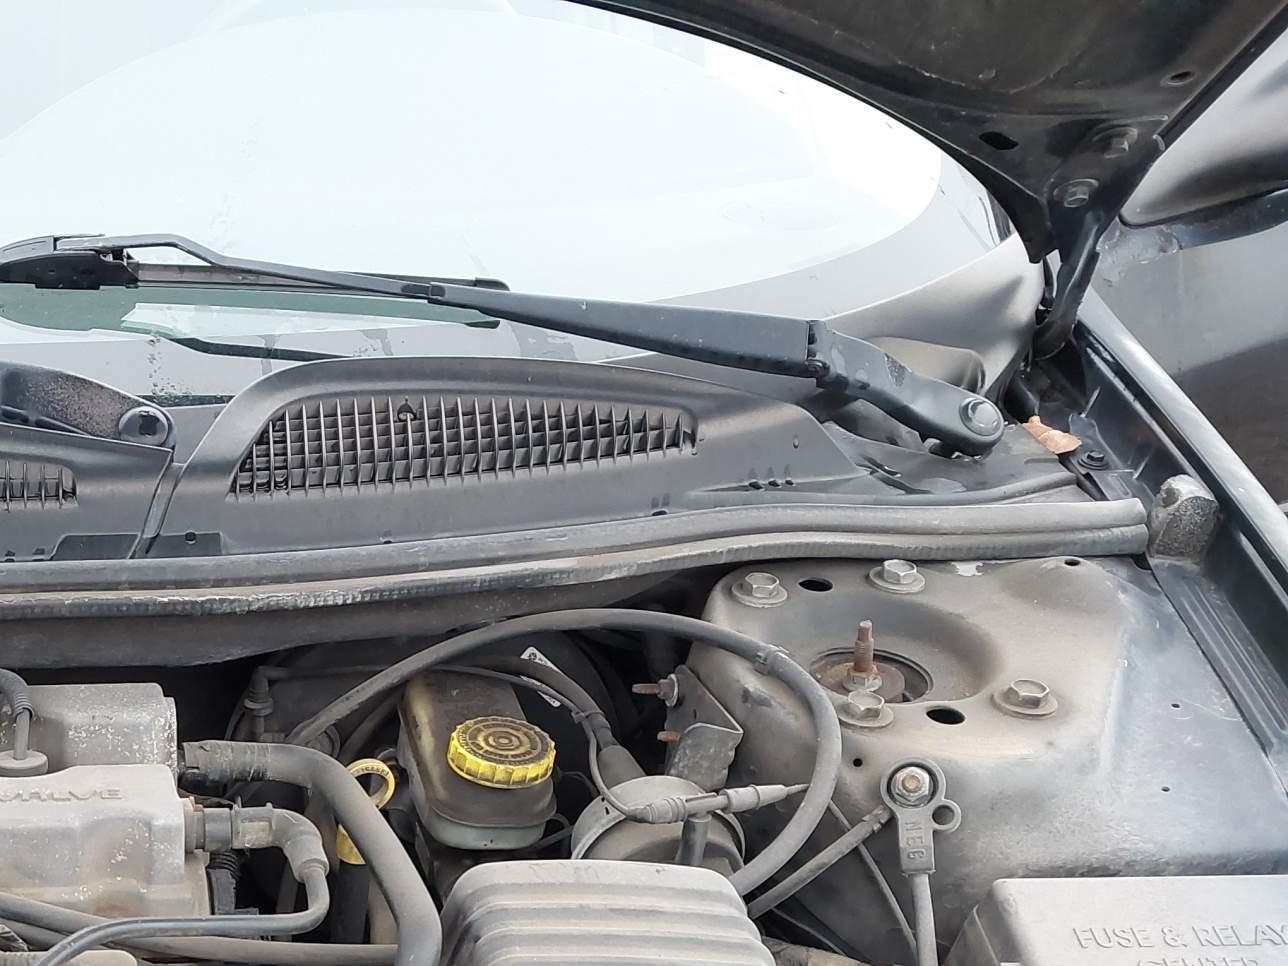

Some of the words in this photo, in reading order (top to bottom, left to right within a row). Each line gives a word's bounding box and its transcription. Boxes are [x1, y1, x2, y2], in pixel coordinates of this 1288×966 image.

[903, 822, 926, 860] NEG
[1073, 926, 1155, 949] FUSE
[1161, 926, 1188, 948] &
[1192, 924, 1288, 947] RELAY
